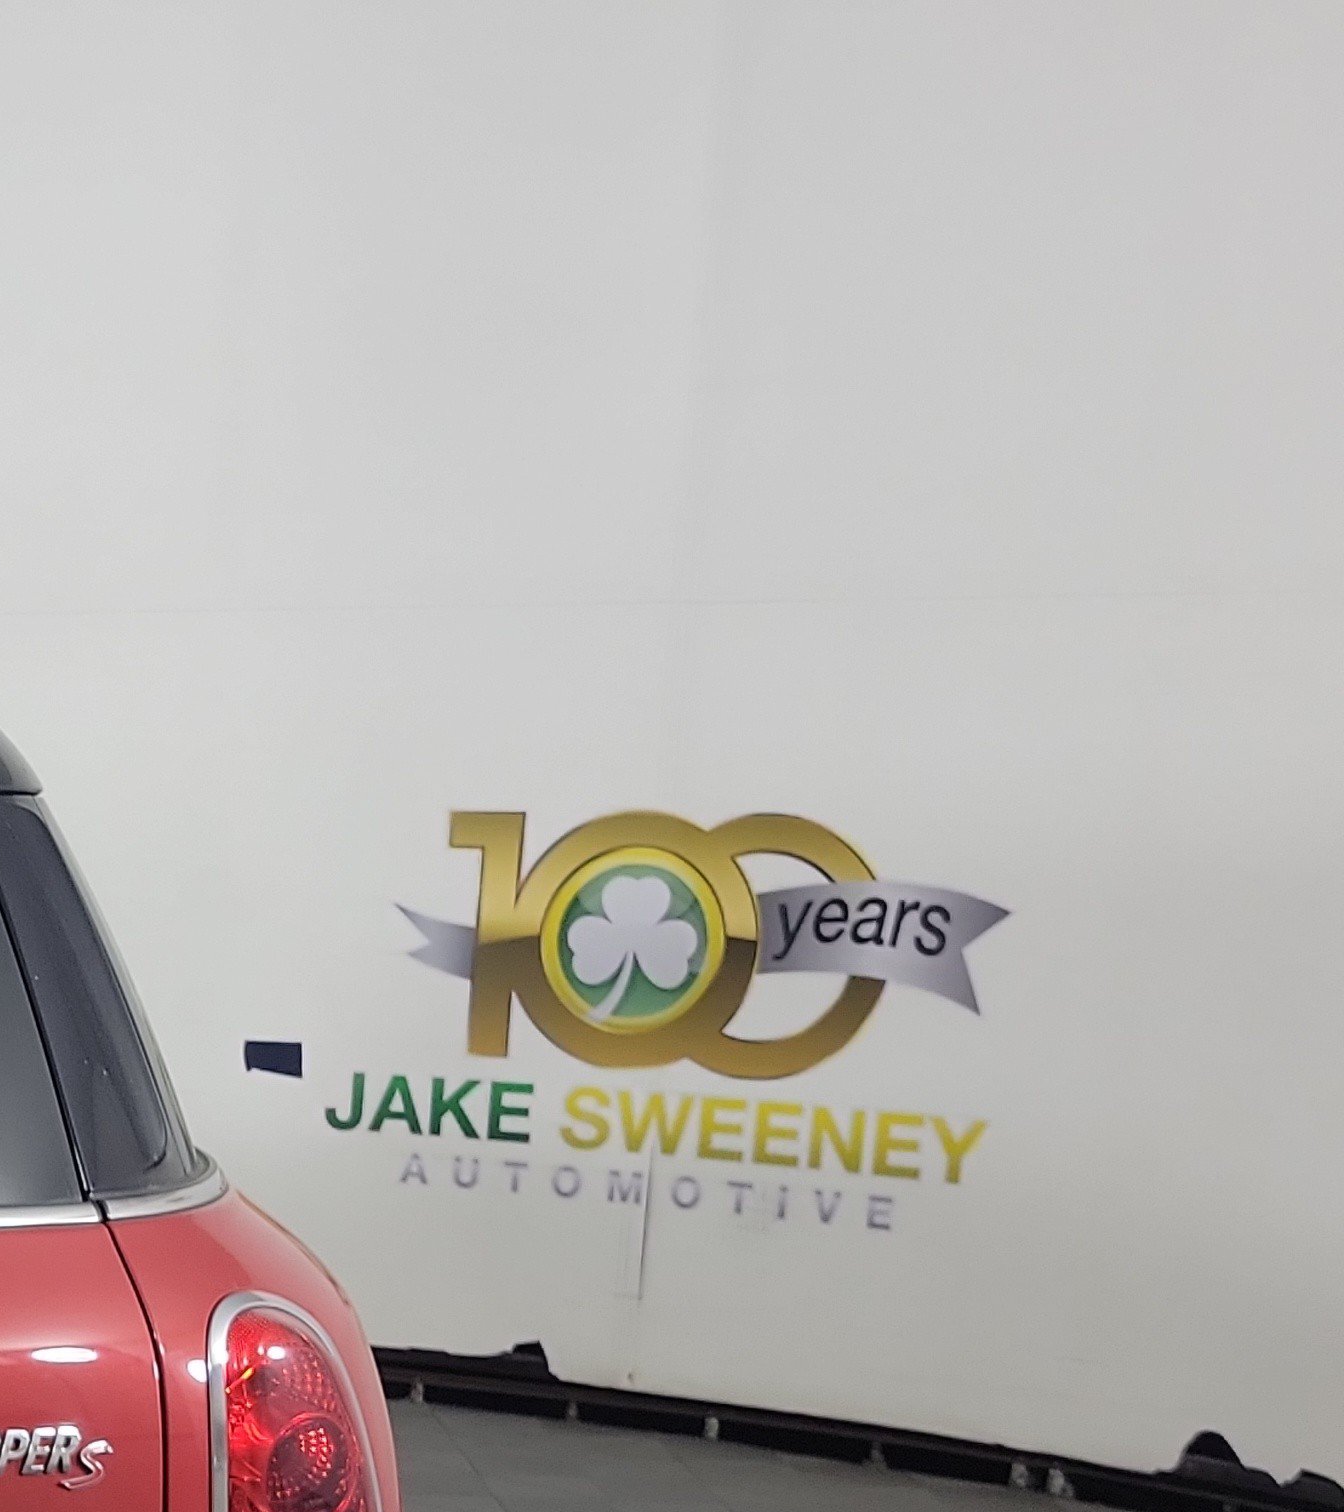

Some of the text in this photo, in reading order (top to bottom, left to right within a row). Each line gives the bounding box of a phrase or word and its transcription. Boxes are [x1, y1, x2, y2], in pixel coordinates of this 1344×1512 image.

[449, 810, 886, 1081] 100
[771, 895, 952, 962] years
[325, 1072, 989, 1185] JAKE SWEENEY
[400, 1152, 896, 1231] AUTOMOTIVE
